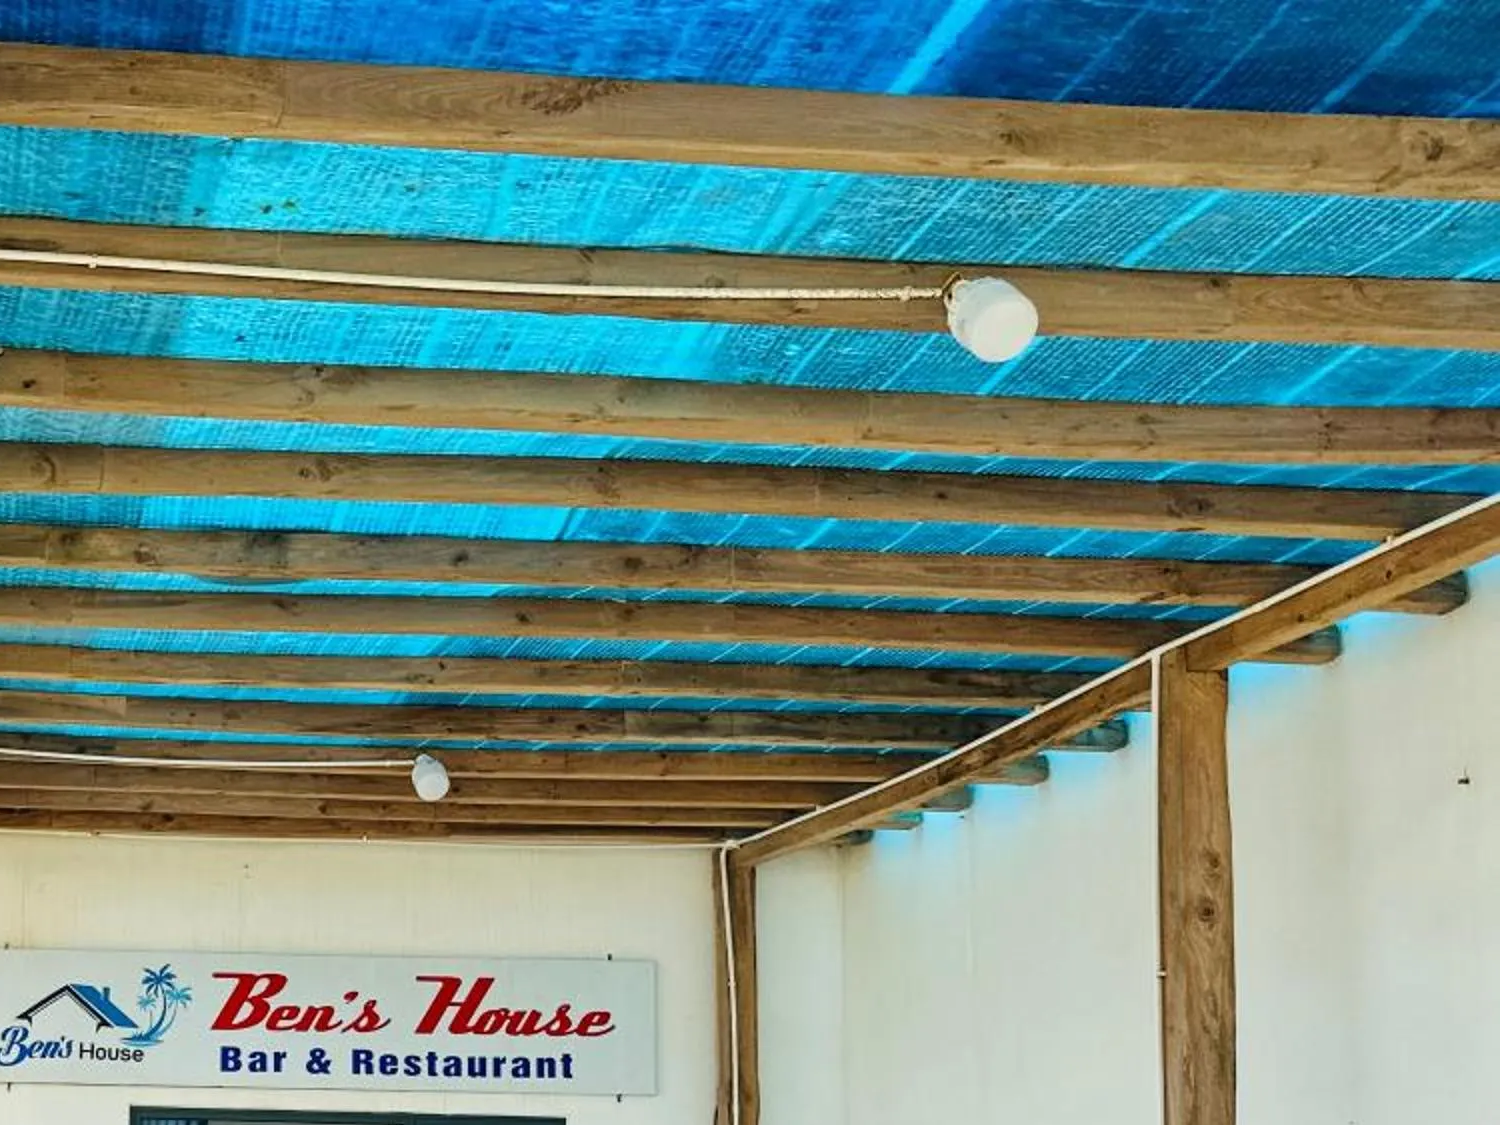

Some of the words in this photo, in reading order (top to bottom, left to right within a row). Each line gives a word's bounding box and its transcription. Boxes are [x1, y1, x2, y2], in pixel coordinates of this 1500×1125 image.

[210, 972, 392, 1034] Ben's
[414, 975, 616, 1037] House
[78, 1042, 145, 1063] House
[219, 1045, 287, 1074] Bar
[305, 1047, 333, 1075] &
[351, 1048, 574, 1079] Restaurant
